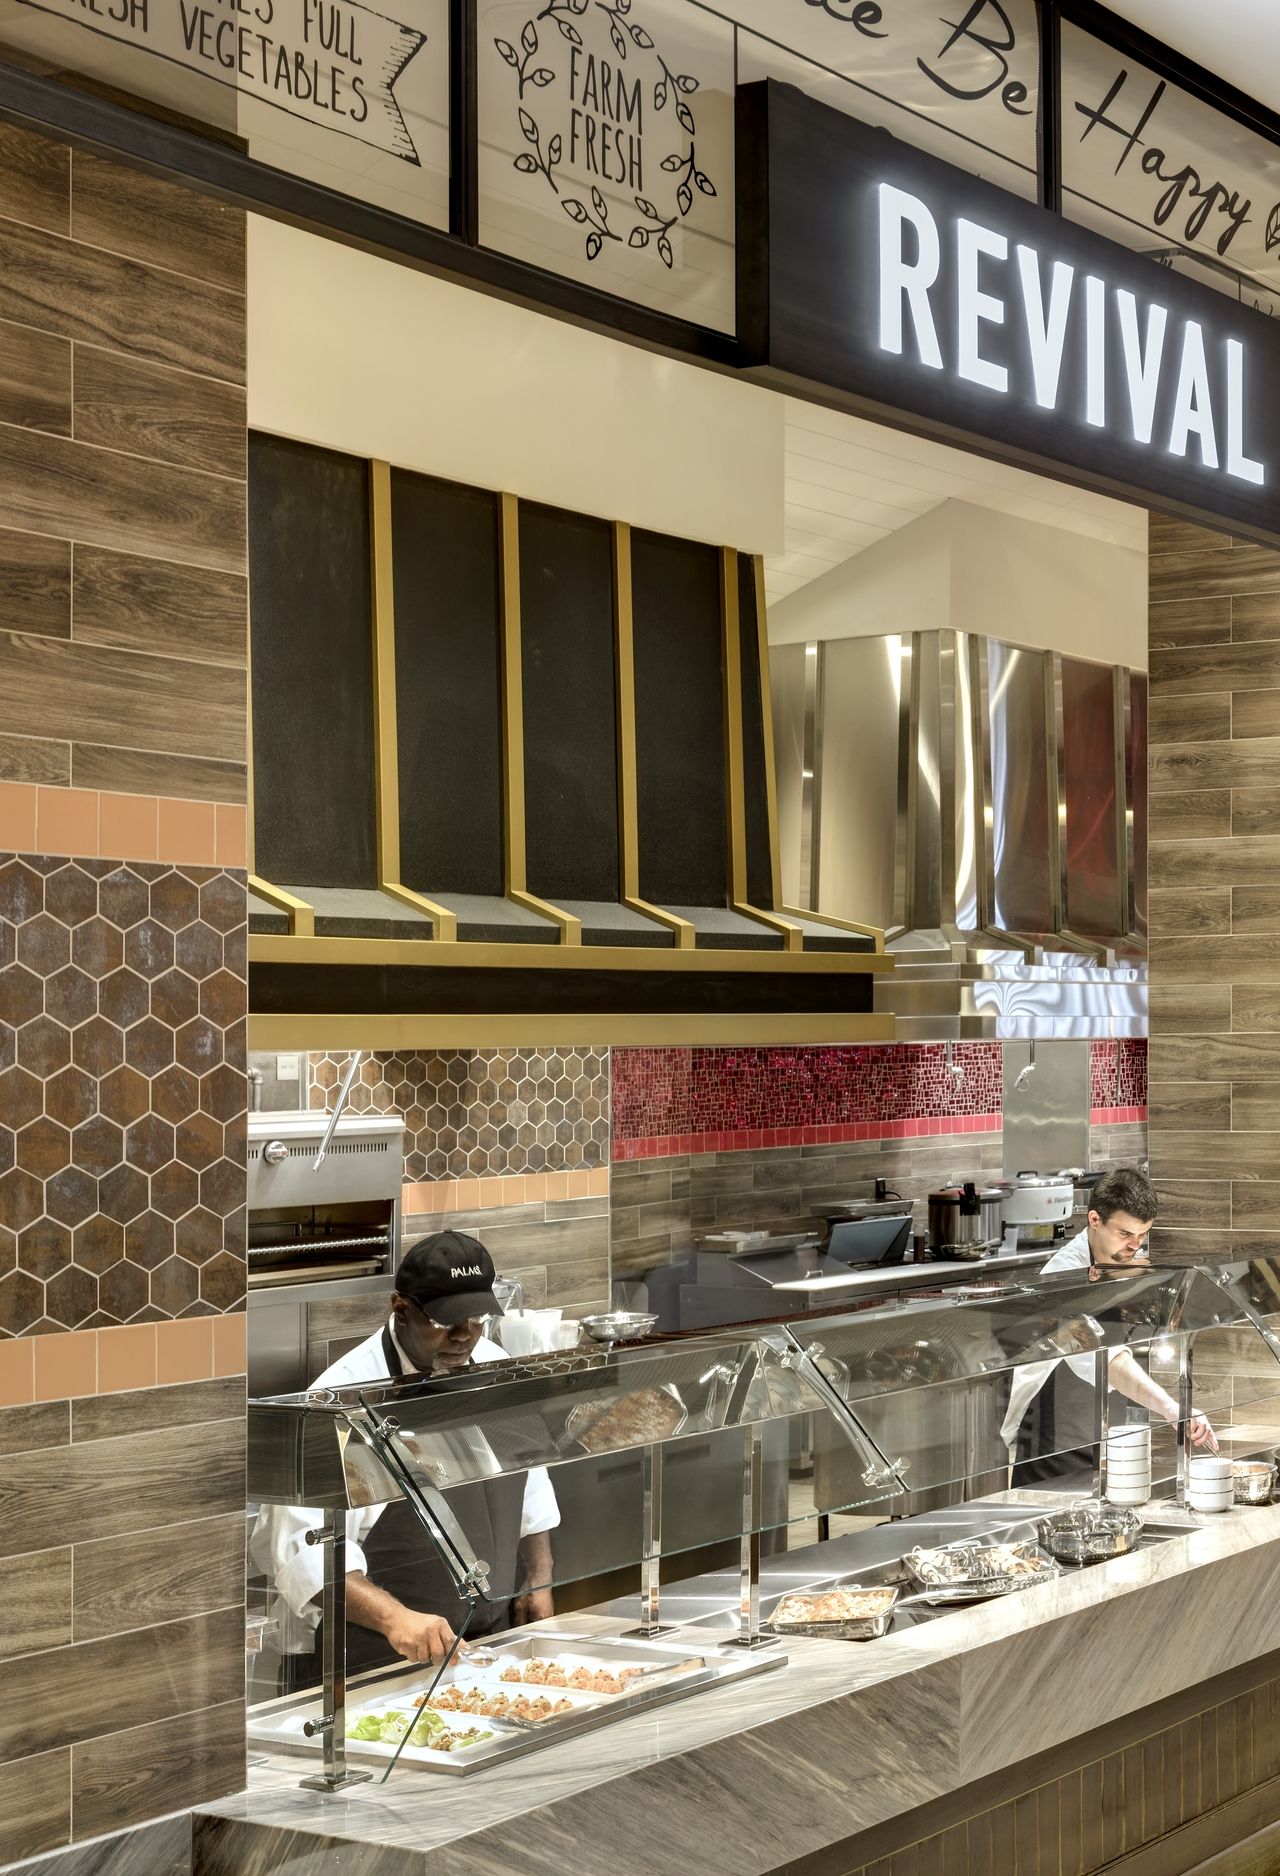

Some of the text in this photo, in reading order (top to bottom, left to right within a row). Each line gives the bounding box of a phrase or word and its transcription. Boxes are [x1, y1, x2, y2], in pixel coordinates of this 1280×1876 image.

[179, 0, 369, 122] VEGETABLES
[303, 2, 363, 66] FULL
[570, 45, 643, 136] FARM
[916, 0, 1033, 116] Be
[1074, 68, 1253, 256] Happy
[569, 109, 643, 192] FRESH
[878, 180, 1266, 486] REVIVAL
